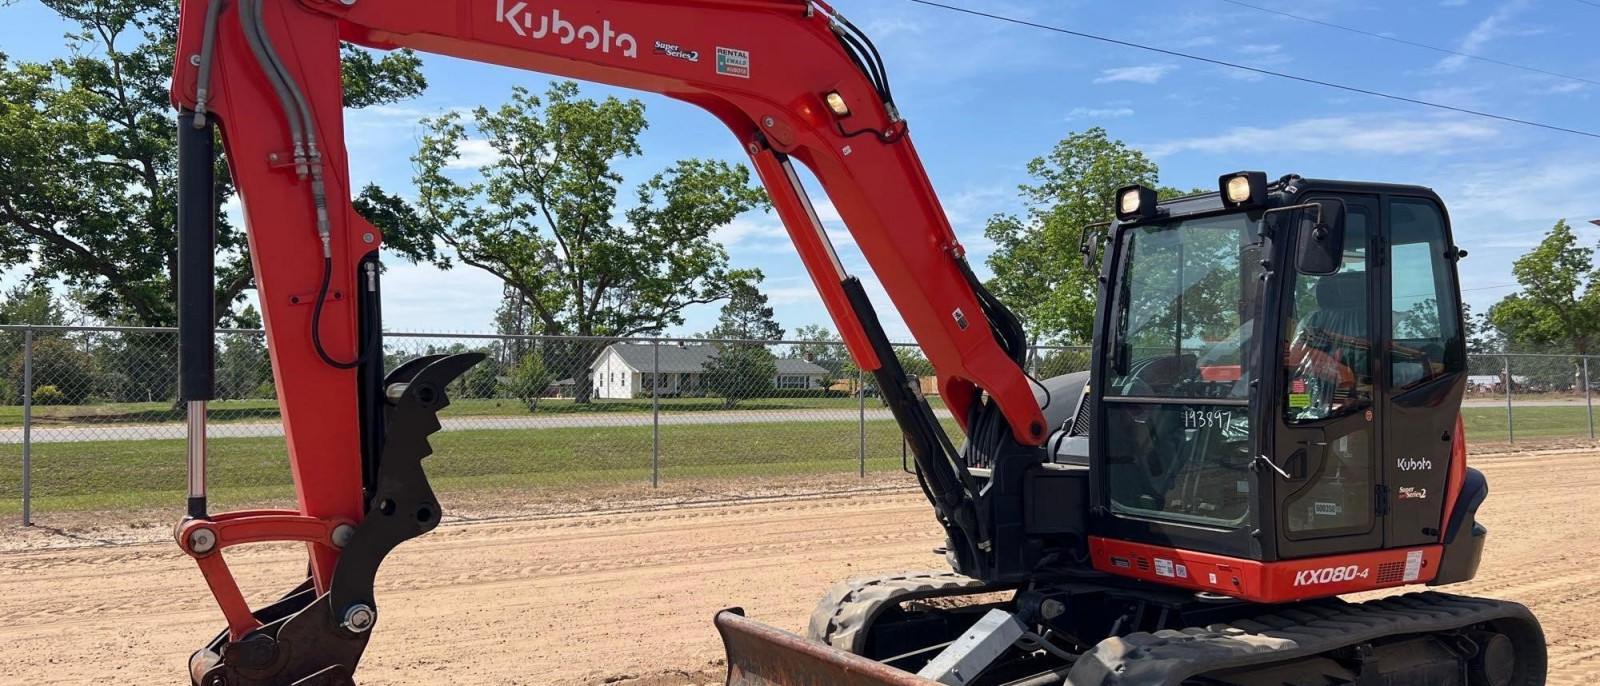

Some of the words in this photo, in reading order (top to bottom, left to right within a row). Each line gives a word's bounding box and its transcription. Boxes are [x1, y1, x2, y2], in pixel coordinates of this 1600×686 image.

[496, 0, 637, 58] Kubota
[654, 40, 679, 51] Super
[717, 48, 748, 59] RENTAL
[1184, 411, 1232, 431] 193897
[1397, 457, 1432, 471] Kubota
[1399, 486, 1415, 494] Super
[1293, 564, 1370, 587] KX080-4
